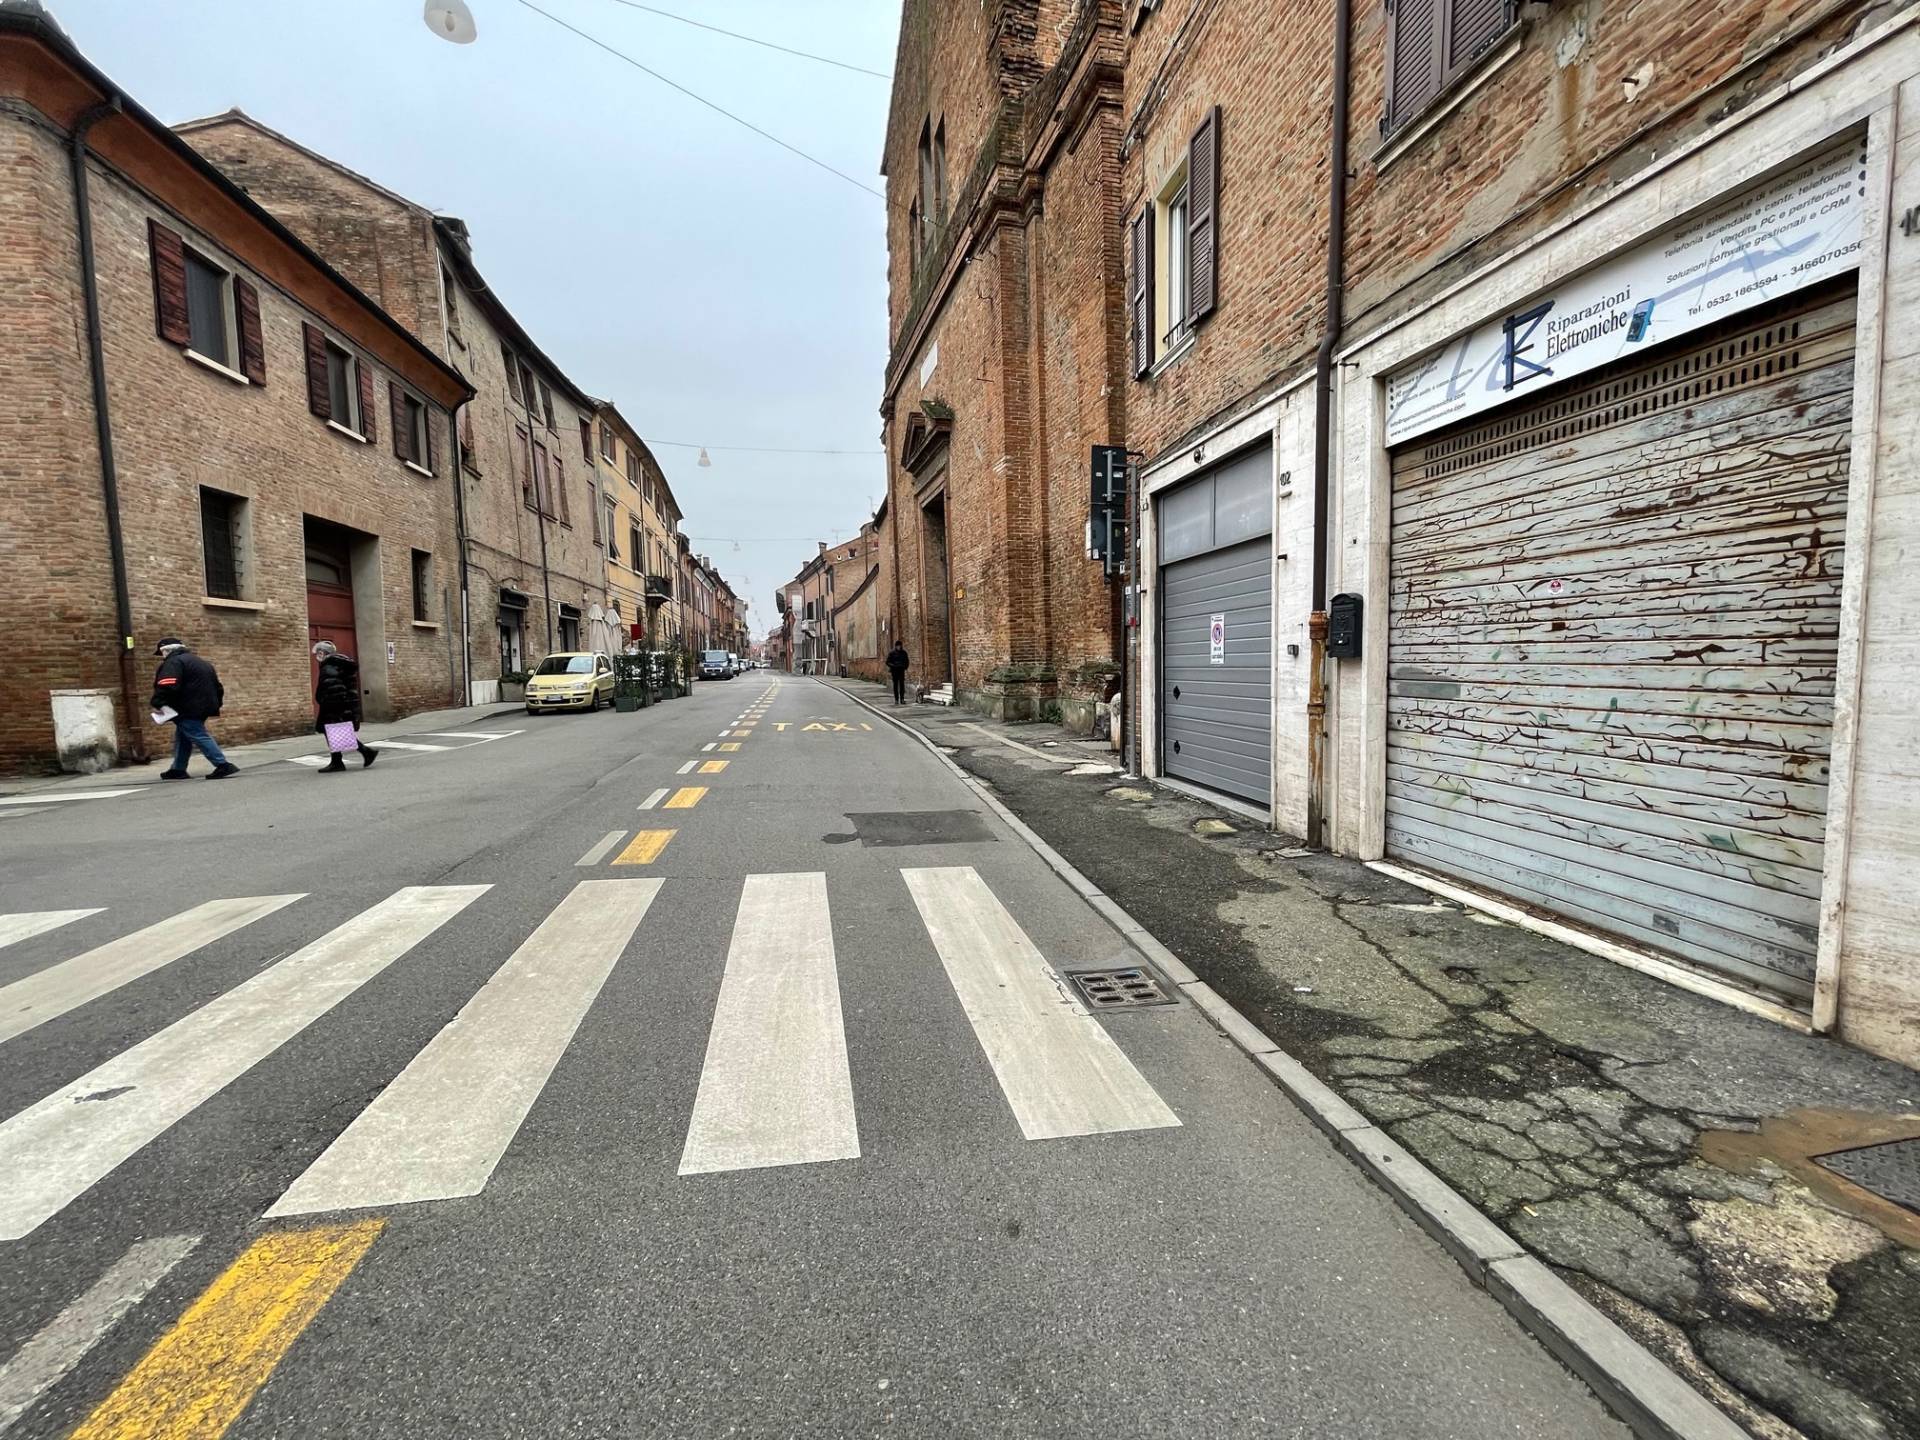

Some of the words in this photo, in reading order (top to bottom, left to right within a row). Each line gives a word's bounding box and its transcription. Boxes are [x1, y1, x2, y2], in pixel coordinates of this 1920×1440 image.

[1664, 236, 1704, 258] Telefonia
[1706, 212, 1752, 239] aziendale
[1755, 207, 1762, 216] e
[1764, 193, 1794, 212] centr.
[1798, 162, 1854, 195] telefonici
[1674, 223, 1704, 241] Servizi
[1706, 201, 1744, 225] internet
[1720, 224, 1757, 246] Vendita
[1760, 214, 1776, 228] PC
[1778, 211, 1786, 219] e
[1788, 181, 1852, 217] periferiche
[1666, 259, 1707, 284] Soluzioni
[1709, 240, 1751, 265] software
[1754, 215, 1807, 246] gestionali
[1809, 212, 1817, 220] e
[1820, 195, 1851, 215] CRM
[1547, 284, 1631, 336] Riparazioni
[1688, 305, 1704, 316] Tel.
[1706, 274, 1778, 309] 0532.1863594
[1546, 309, 1628, 360] Elettroniche
[771, 722, 873, 732] TAXI
